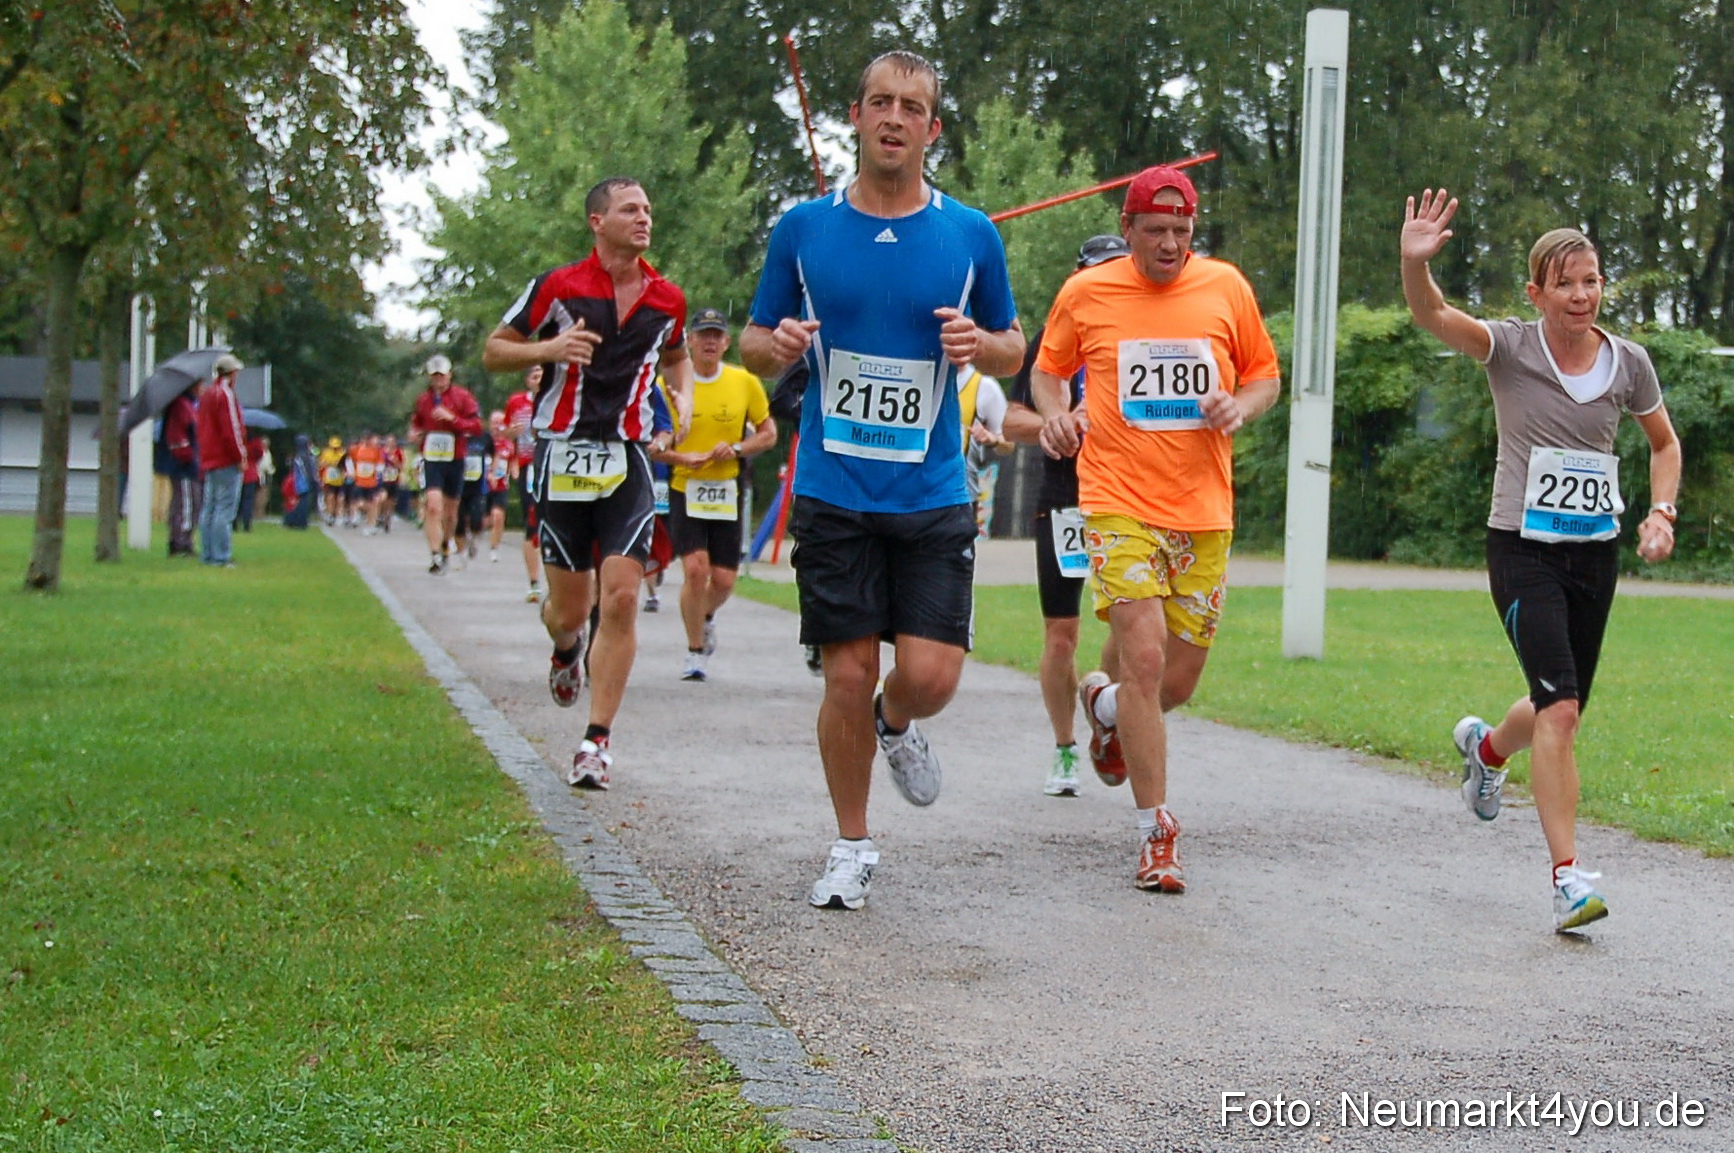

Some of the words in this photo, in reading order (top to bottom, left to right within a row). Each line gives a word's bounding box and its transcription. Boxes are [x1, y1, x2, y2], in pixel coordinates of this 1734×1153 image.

[1130, 363, 1210, 396] 2180
[835, 378, 922, 424] 2158
[1145, 404, 1195, 419] Rüdiger
[851, 427, 896, 446] Martin
[565, 450, 611, 474] 217
[697, 486, 727, 502] 204
[1536, 473, 1614, 513] 2293
